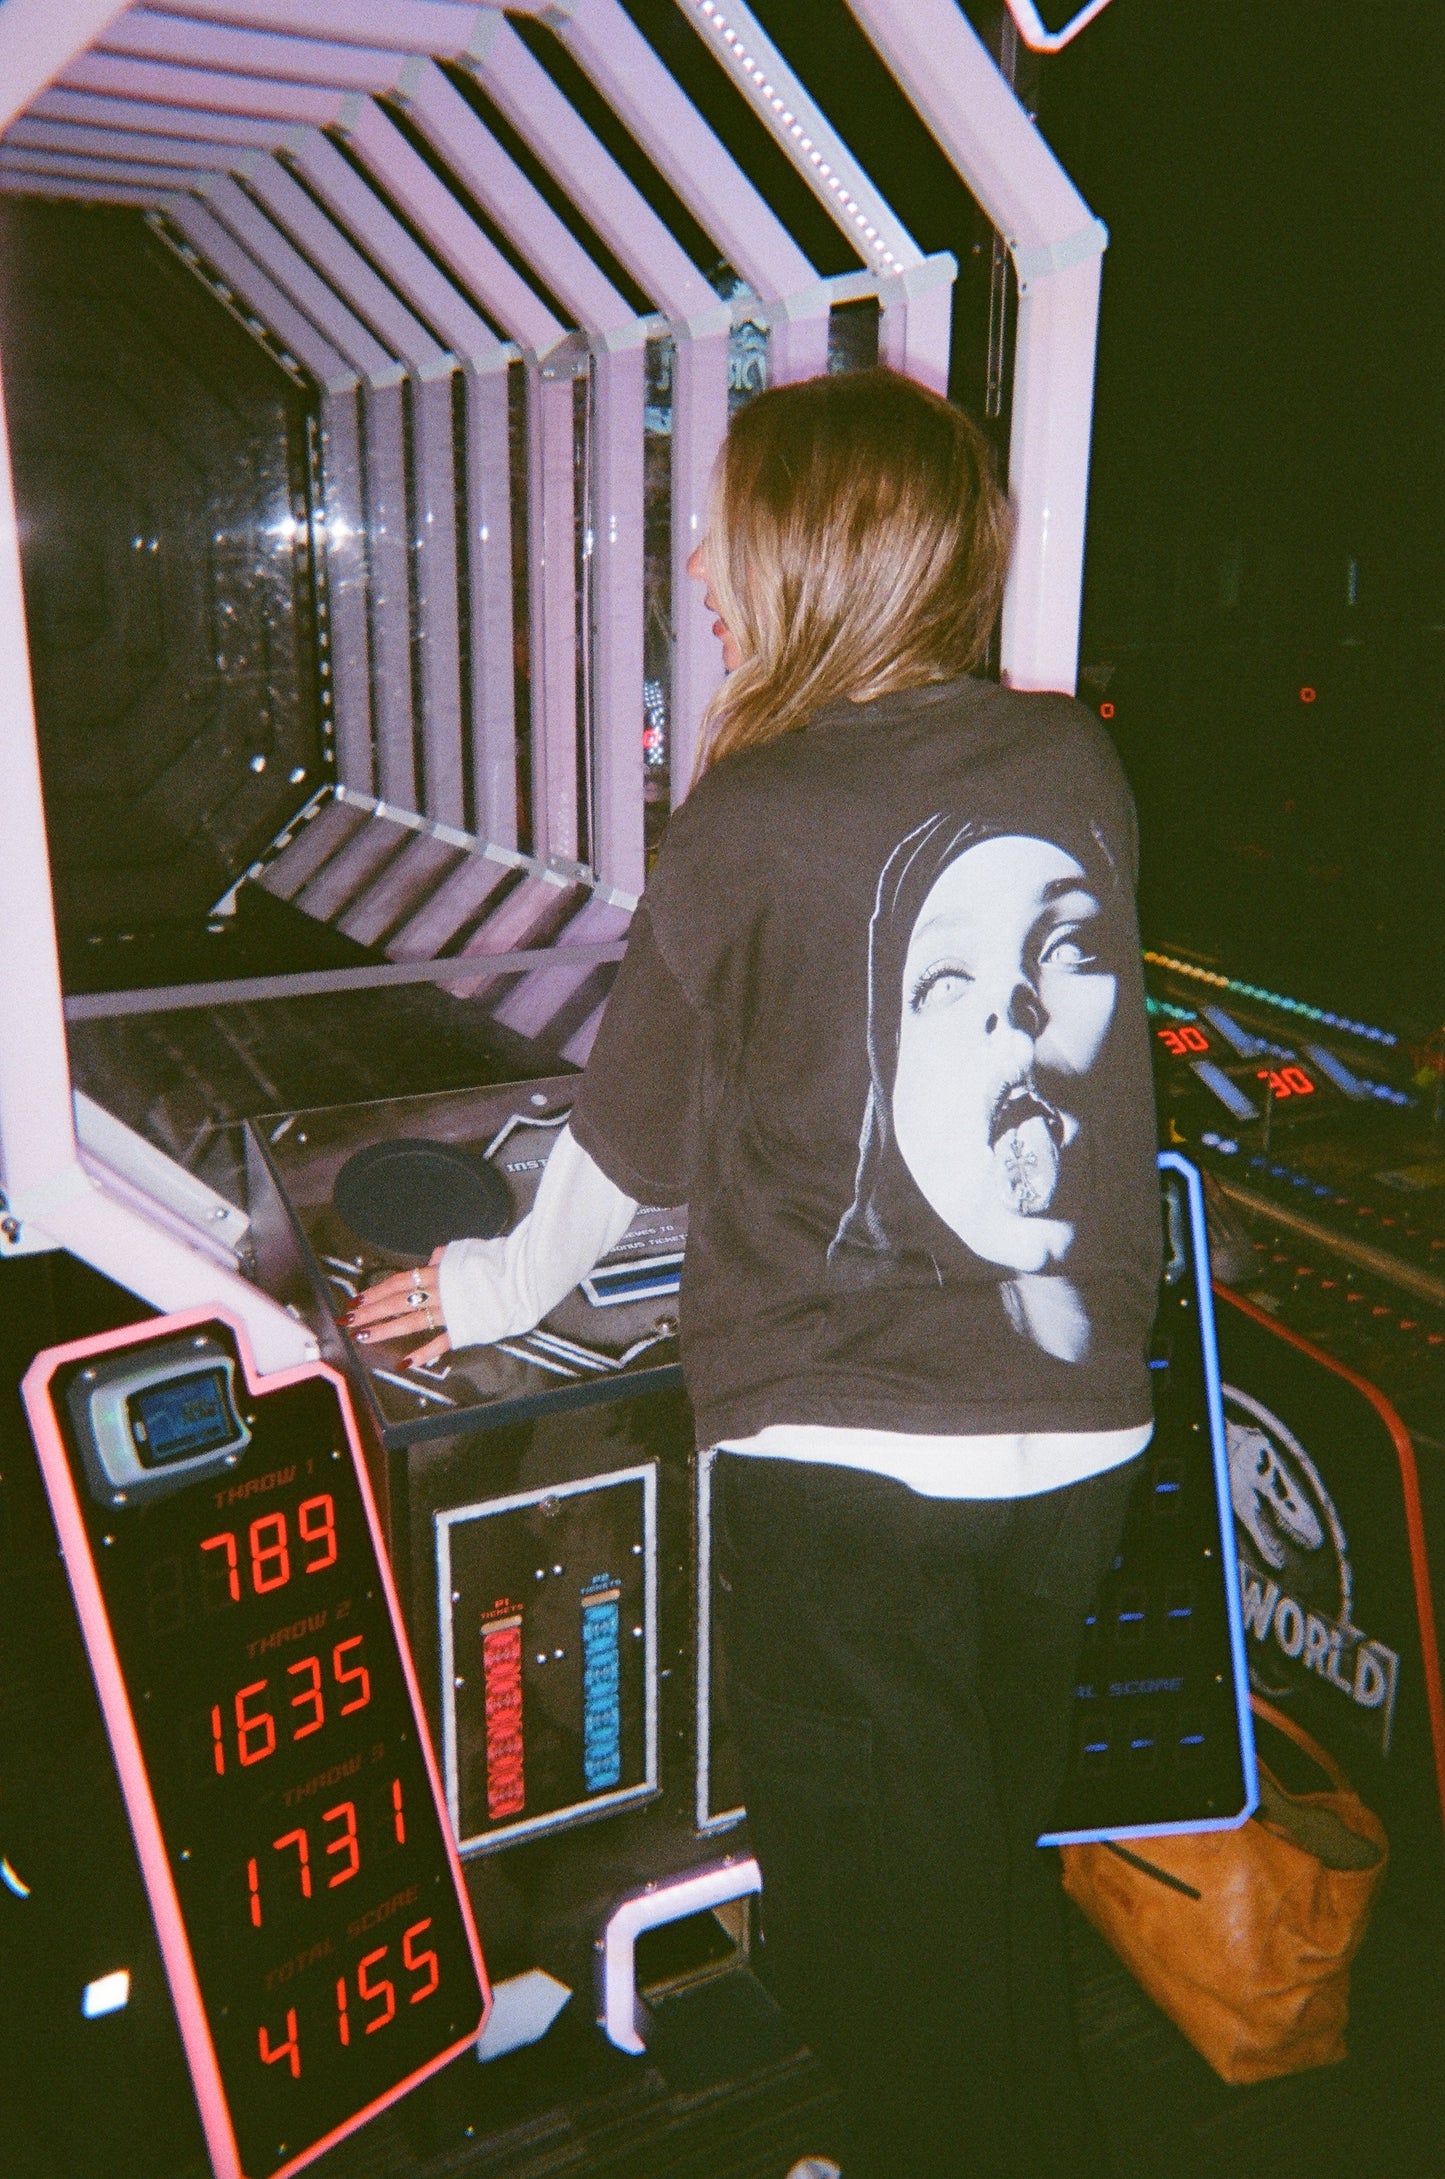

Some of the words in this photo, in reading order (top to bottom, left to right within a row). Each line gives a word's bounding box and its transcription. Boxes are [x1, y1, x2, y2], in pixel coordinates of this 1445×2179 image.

[1157, 1026, 1209, 1055] 30
[1256, 1066, 1315, 1098] 30
[214, 1464, 297, 1509] THROW
[304, 1459, 315, 1477] 1
[200, 1493, 338, 1602] 789
[246, 1612, 327, 1660] THROW
[335, 1600, 352, 1619] 2
[1239, 1560, 1387, 1708] WORLD
[210, 1634, 372, 1775] 1635
[282, 1756, 362, 1808] THROW
[368, 1744, 385, 1763] 3
[246, 1778, 406, 1928] 1731
[263, 1941, 334, 1991] TOTAL
[346, 1884, 420, 1938] SCORE
[257, 1917, 440, 2078] 4155
